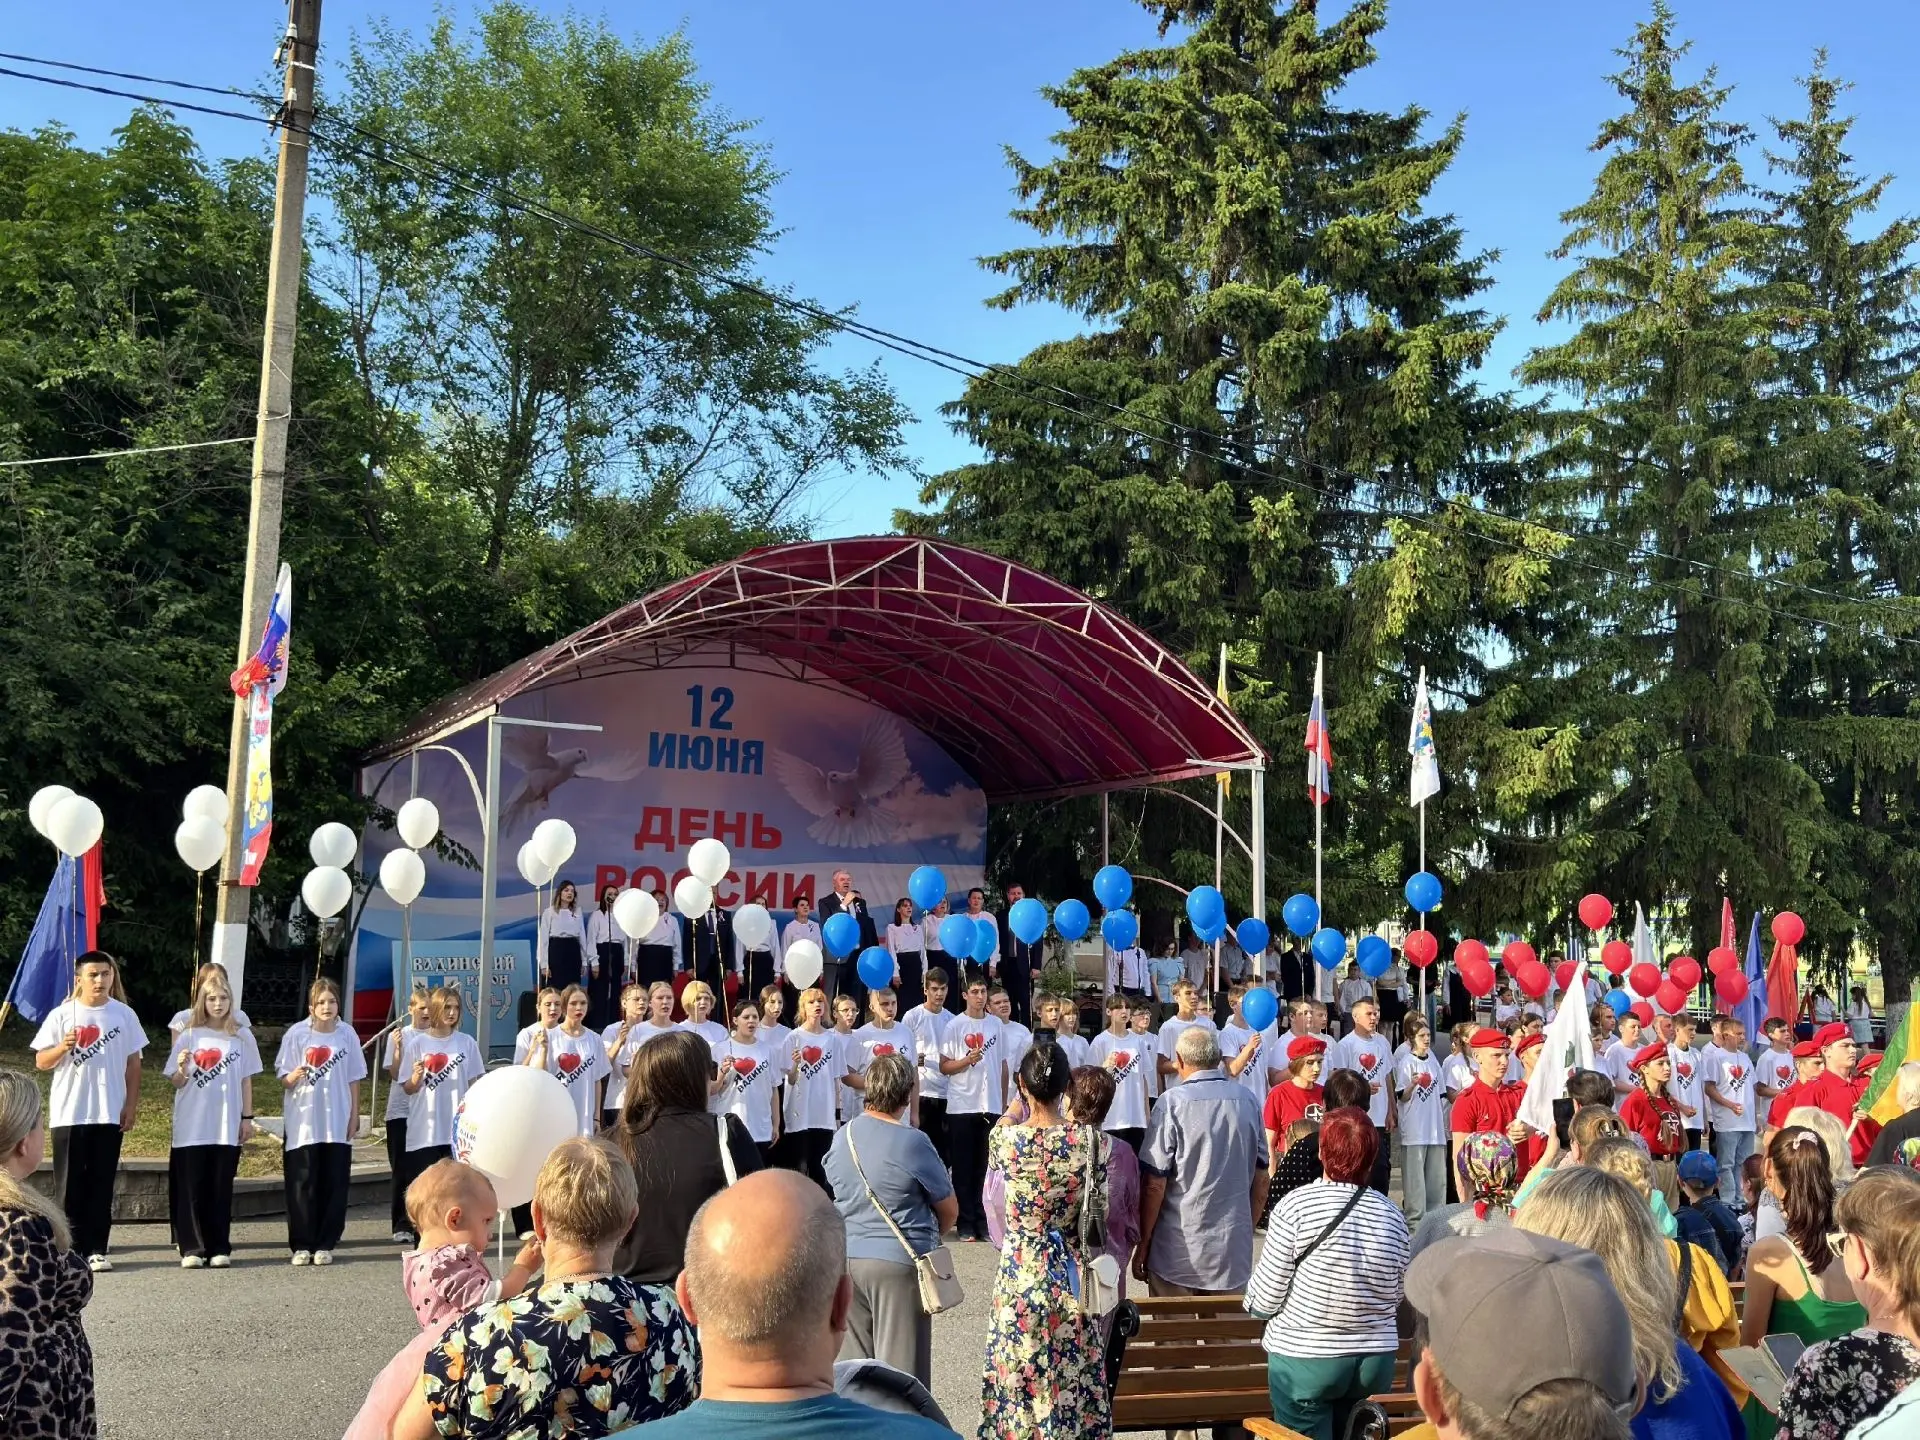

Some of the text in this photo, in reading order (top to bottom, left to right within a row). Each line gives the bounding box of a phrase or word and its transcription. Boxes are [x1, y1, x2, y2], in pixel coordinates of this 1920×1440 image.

[686, 684, 735, 731] 12
[648, 731, 764, 775] ИЮНЯ
[634, 806, 782, 852] ДЕНЬ
[412, 953, 516, 973] ВАДИНСИЙ
[73, 1026, 121, 1067] ВАДИНСК
[192, 1067, 204, 1082] Я
[196, 1049, 240, 1089] ВАДИНСК
[309, 1047, 348, 1087] ВАДИНСК
[427, 1052, 466, 1091] ВАДИНСК
[800, 1063, 810, 1075] Я
[1628, 1072, 1639, 1083] Я
[1676, 1075, 1685, 1085] Я
